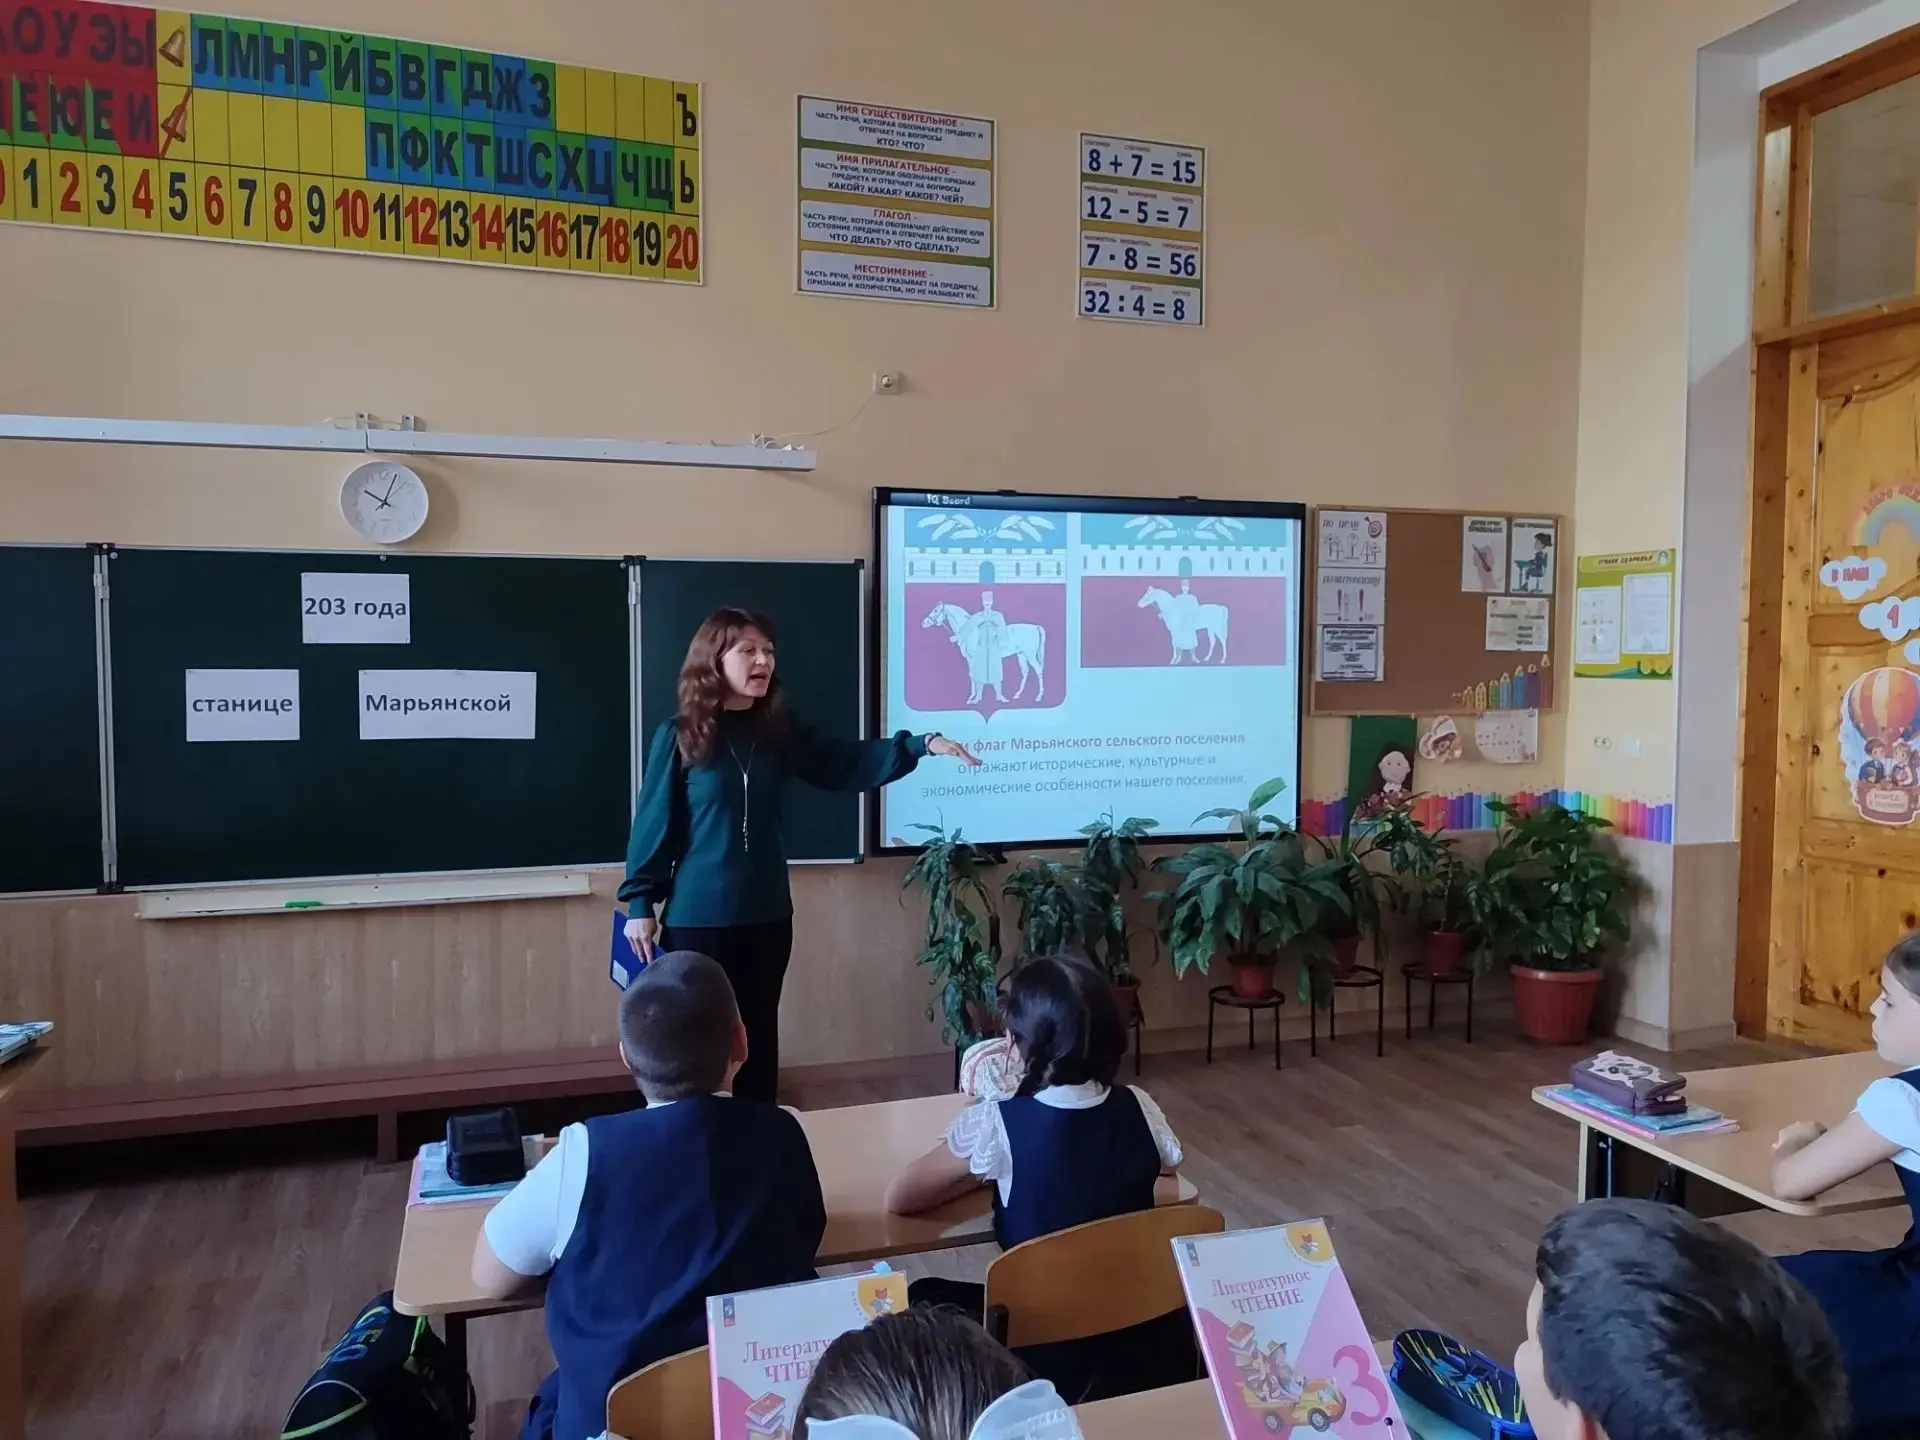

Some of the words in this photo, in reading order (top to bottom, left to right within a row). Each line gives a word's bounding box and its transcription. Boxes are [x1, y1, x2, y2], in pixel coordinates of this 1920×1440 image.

[815, 111, 839, 121] ЧАСТЬ
[840, 114, 861, 125] РЕЧИ,
[863, 117, 896, 128] КОТОРАЯ
[897, 121, 943, 134] ОБОЗНАЧАЕТ
[945, 128, 976, 139] ПРЕДМЕТ
[836, 104, 859, 115] ИМЯ
[861, 107, 958, 128] СУЩЕСТВИТЕЛЬНОЕ
[859, 126, 895, 136] ОТВЕЧАЕТ
[896, 130, 906, 138] НА
[908, 131, 942, 142] ВОПРОСЫ
[876, 137, 900, 148] КТО?
[902, 140, 925, 151] ЧТО?
[815, 161, 838, 171] ЧАСТЬ
[839, 164, 861, 175] РЕЧИ,
[862, 167, 896, 178] КОТОРАЯ
[897, 171, 943, 183] ОБОЗНАЧАЕТ
[944, 176, 977, 187] ПРИЗНАК
[836, 153, 859, 164] ИМЯ
[861, 156, 950, 176] ПРИЛАГАТЕЛЬНОЕ
[1088, 149, 1101, 172] 8
[1131, 154, 1143, 176] 7
[1172, 160, 1196, 184] 15
[828, 180, 865, 193] КАКОЙ?
[867, 186, 902, 197] КАКАЯ?
[904, 190, 939, 201] КАКОЕ?
[941, 193, 964, 204] ЧЕЙ?
[831, 172, 870, 183] ПРЕДМЕТА
[878, 177, 914, 188] ОТВЕЧАЕТ
[915, 181, 925, 189] НА
[926, 183, 961, 193] ВОПРОСЫ
[23, 158, 38, 208] 1
[59, 161, 81, 213] 2
[96, 165, 116, 215] 3
[132, 169, 154, 219] 4
[168, 172, 188, 221] 5
[204, 176, 225, 226] 6
[238, 178, 257, 226] 7
[273, 182, 294, 232] 8
[307, 185, 326, 233] 9
[335, 188, 369, 238] 10
[373, 192, 400, 241] 11
[405, 196, 438, 245] 12
[439, 200, 469, 248] 13
[471, 203, 505, 251] 14
[506, 207, 535, 254] 15
[536, 211, 568, 258] 16
[569, 214, 598, 260] 17
[600, 217, 630, 264] 18
[633, 221, 661, 267] 19
[666, 224, 699, 271] 20
[873, 209, 911, 221] ГЛАГОЛ
[1087, 196, 1112, 220] 12
[1137, 201, 1148, 224] 5
[1177, 206, 1189, 228] 7
[803, 212, 826, 220] ЧАСТЬ
[828, 214, 849, 224] РЕЧИ,
[851, 217, 884, 227] КОТОРАЯ
[885, 220, 931, 231] ОБОЗНАЧАЕТ
[932, 224, 968, 236] ДЕЙСТВИЕ
[969, 229, 985, 237] ИЛИ
[807, 221, 851, 231] СОСТОЯНИЕ
[852, 225, 890, 236] ПРЕДМЕТА
[899, 230, 933, 241] ОТВЕЧАЕТ
[946, 235, 980, 245] ВОПРОСЫ
[829, 233, 849, 242] ЧТО
[850, 235, 892, 247] ДЕЛАТЬ?
[894, 239, 912, 249] ЧТО
[914, 242, 960, 253] СДЕЛАТЬ?
[854, 264, 927, 278] МЕСТОИМЕНИЕ
[1087, 244, 1100, 266] 7
[1124, 247, 1138, 270] 8
[1170, 253, 1196, 276] 56
[804, 270, 828, 279] ЧАСТЬ
[829, 271, 850, 280] РЕЧИ,
[852, 273, 885, 283] КОТОРАЯ
[886, 276, 927, 287] УКАЗЫВАЕТ
[940, 282, 980, 293] ПРЕДМЕТЫ,
[1084, 290, 1110, 314] 32
[1132, 295, 1145, 316] 4
[1173, 298, 1185, 321] 8
[942, 495, 970, 505] Board
[304, 597, 346, 616] 203
[354, 599, 407, 620] года
[192, 697, 293, 716] станице
[365, 694, 512, 716] Марьянской
[973, 738, 1007, 754] флаг
[1011, 738, 1101, 753] Марьянского
[1106, 735, 1172, 748] сельского
[1175, 733, 1245, 746] поселения
[958, 760, 1028, 776] отражают
[1030, 757, 1125, 772] исторические,
[1129, 755, 1205, 769] культурные
[1208, 756, 1216, 764] и
[922, 781, 1032, 798] экономические
[1035, 777, 1122, 792] особенности
[1124, 776, 1173, 790] нашего
[1176, 774, 1248, 787] поселения.
[1212, 1270, 1311, 1297] Литературное
[1232, 1287, 1304, 1314] ЧТЕНИЕ
[743, 1337, 834, 1365] Литерату
[1332, 1344, 1389, 1426] 3
